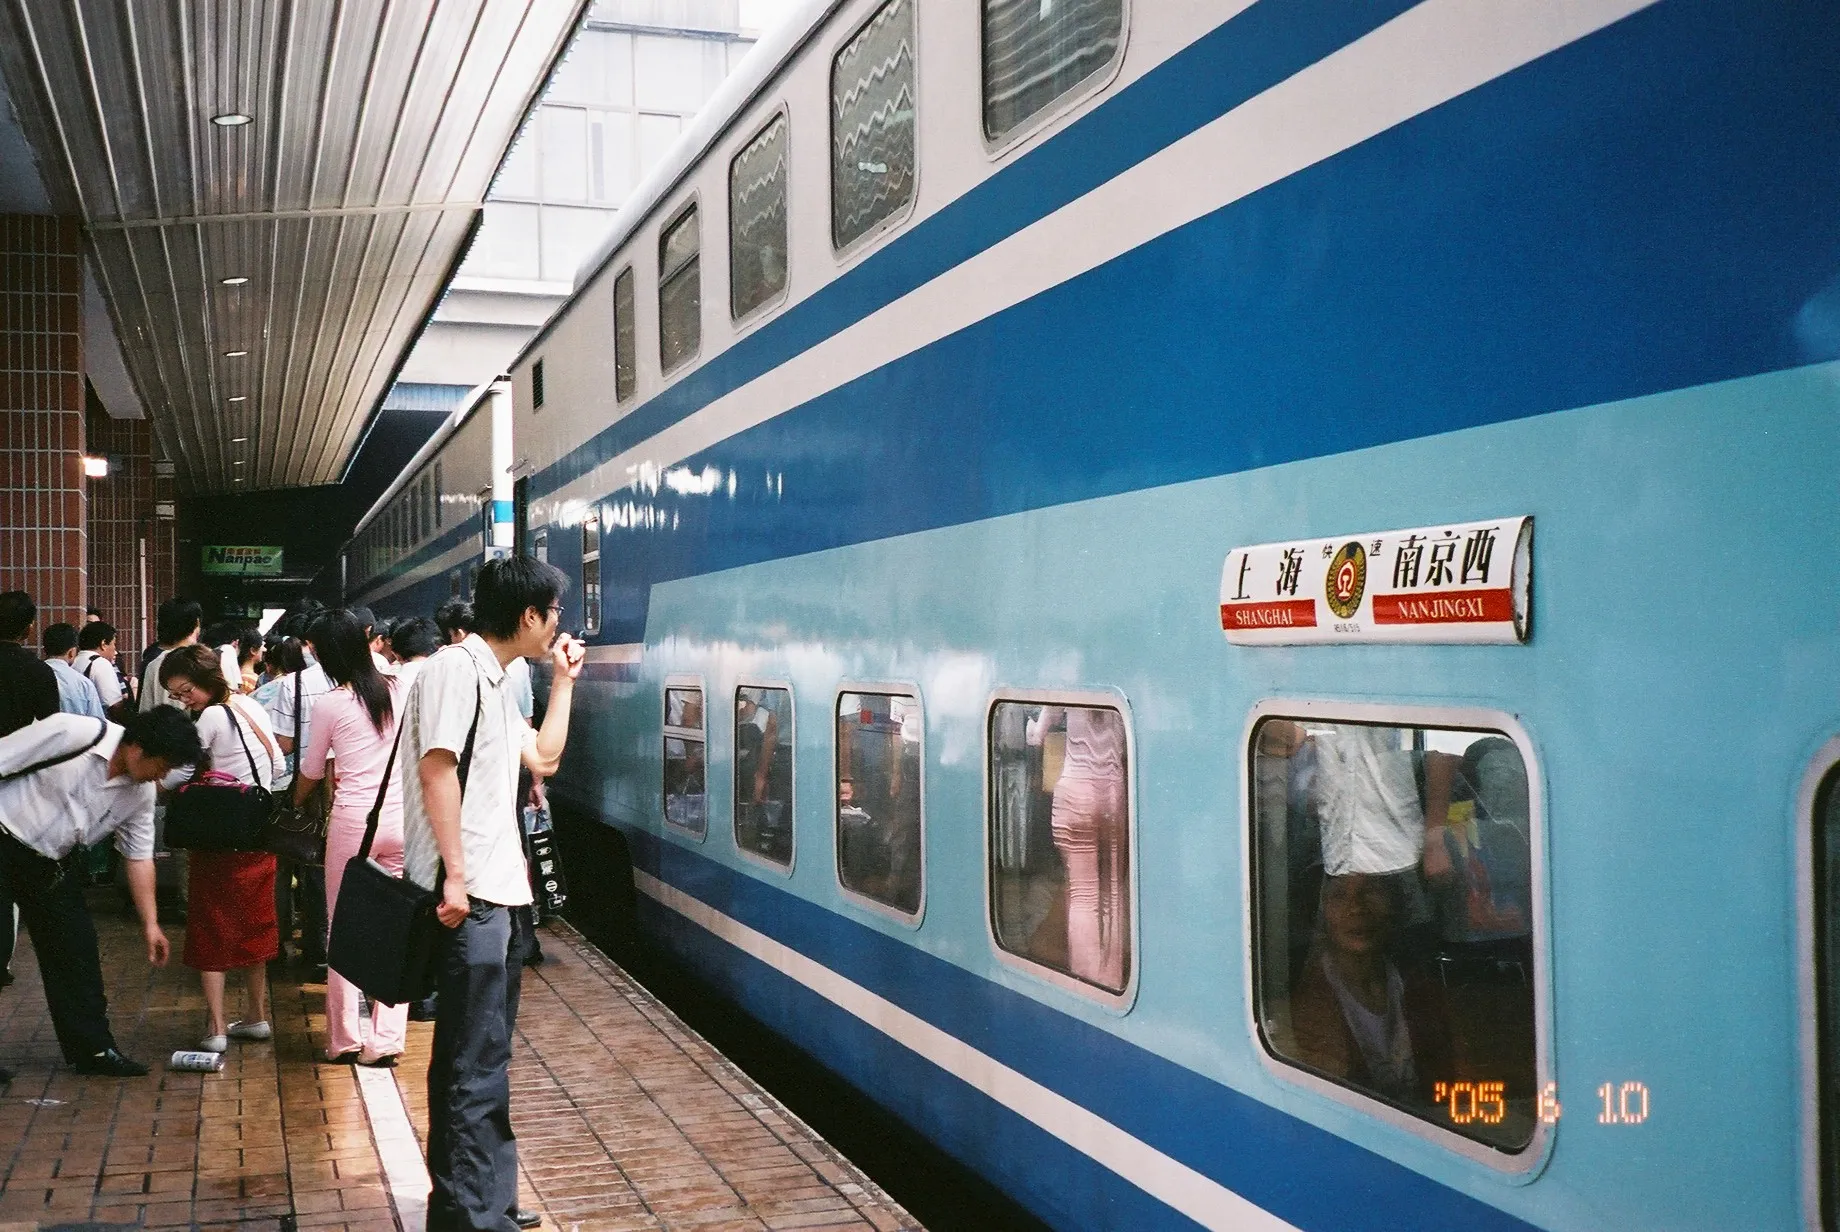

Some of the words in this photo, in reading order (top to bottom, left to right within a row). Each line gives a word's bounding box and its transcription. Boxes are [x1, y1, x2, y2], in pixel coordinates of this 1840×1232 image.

[1231, 547, 1304, 600] 上海
[1392, 526, 1500, 588] 南京西
[1235, 608, 1294, 625] SHANGHAI
[1398, 598, 1485, 619] NANJINGXI
